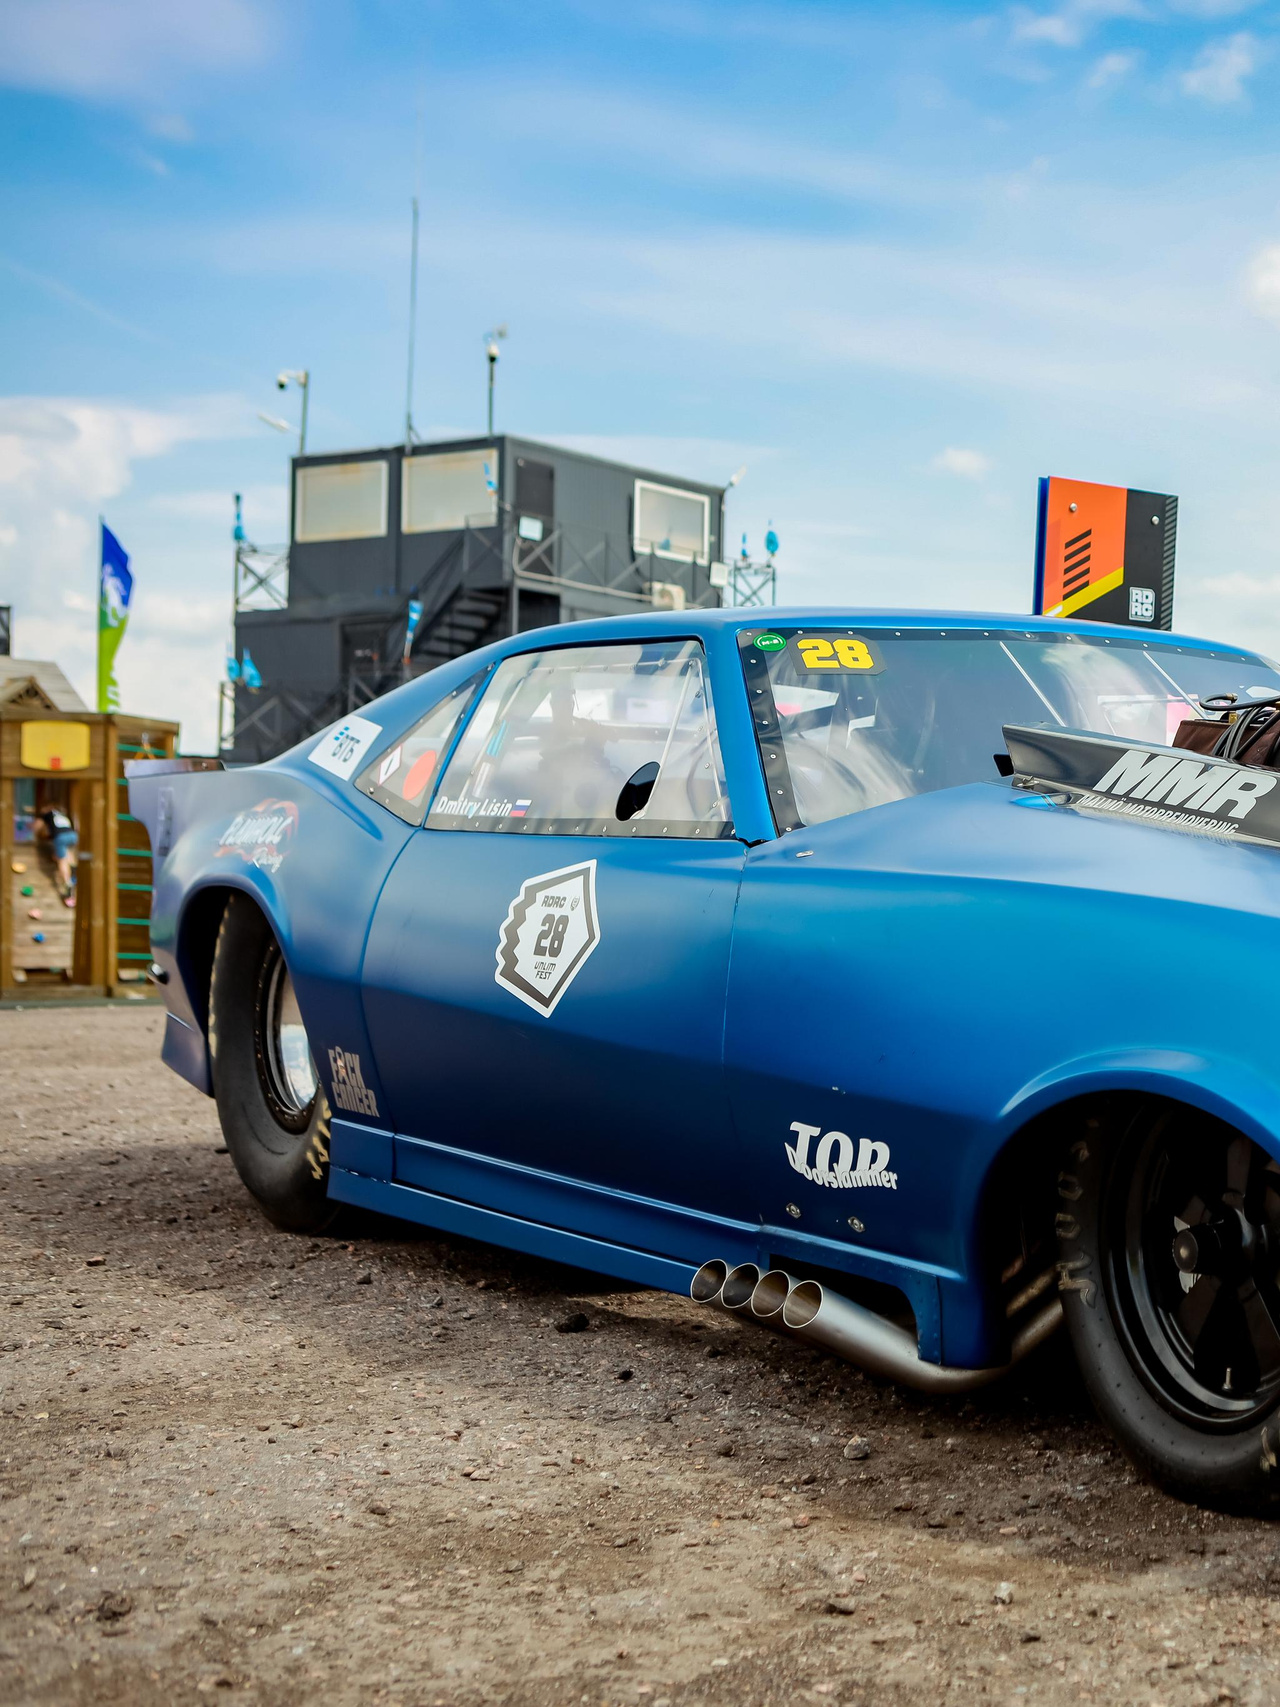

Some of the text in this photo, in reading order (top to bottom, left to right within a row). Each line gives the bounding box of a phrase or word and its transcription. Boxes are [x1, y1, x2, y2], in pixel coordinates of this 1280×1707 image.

[796, 638, 875, 669] 28
[435, 795, 513, 819] Dmitry Lisin
[1092, 749, 1278, 820] MMR
[533, 913, 570, 958] 28
[535, 970, 552, 980] FEST
[784, 1142, 899, 1190] Doorslammer
[789, 1121, 891, 1173] TOP
